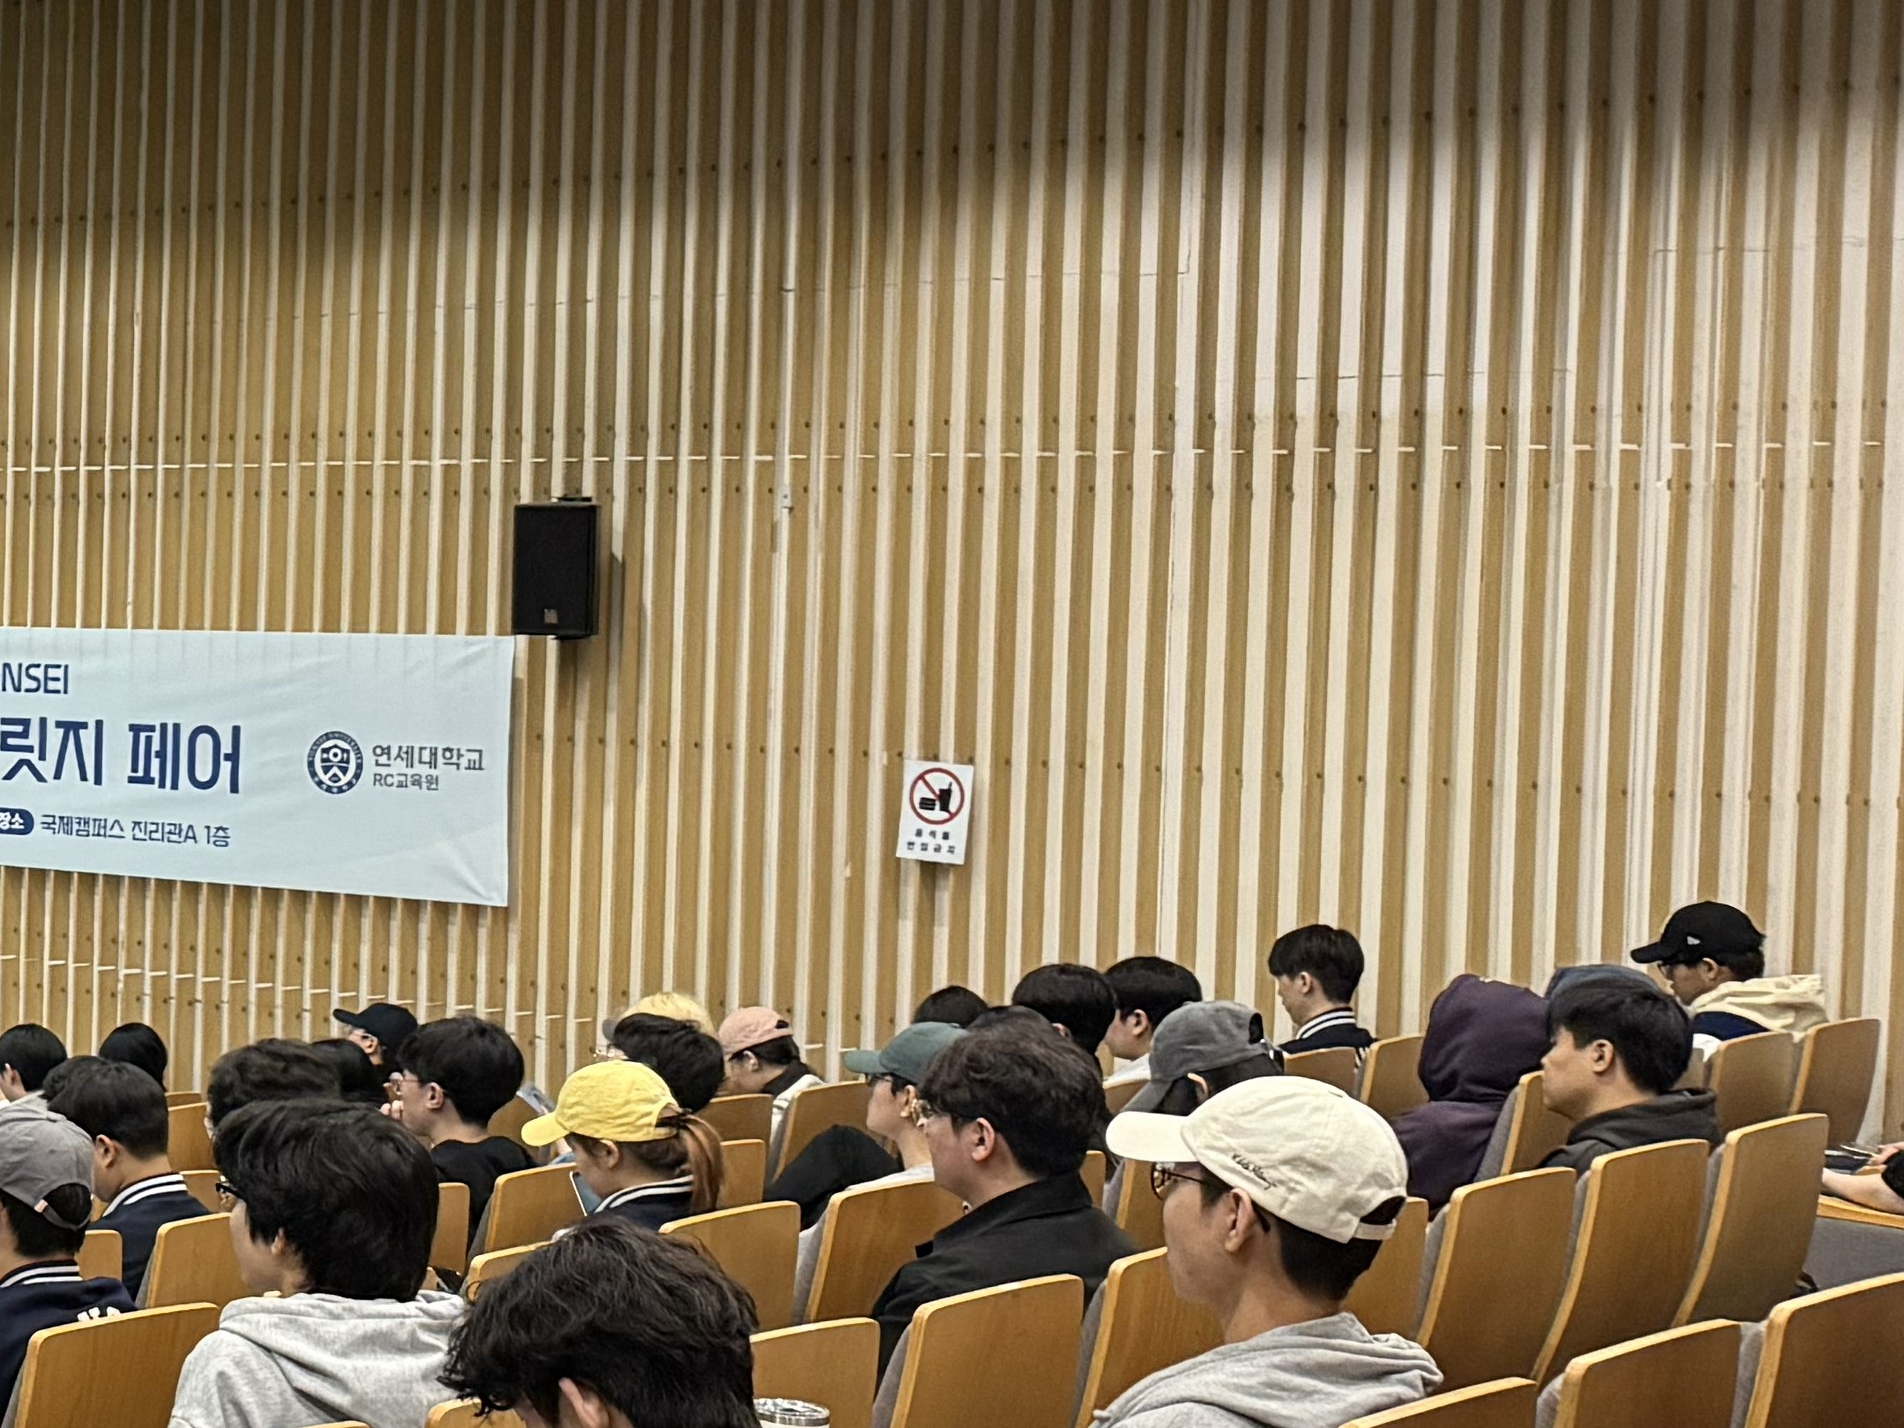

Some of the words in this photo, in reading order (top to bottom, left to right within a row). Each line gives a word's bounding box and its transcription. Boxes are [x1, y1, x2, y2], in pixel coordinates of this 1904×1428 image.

[127, 722, 241, 794] 페어
[372, 744, 485, 771] 연세대학교
[373, 772, 439, 791] RC교육원
[40, 814, 126, 839] 국제캠퍼스
[131, 820, 198, 844] 진리관A
[204, 825, 231, 848] 1층
